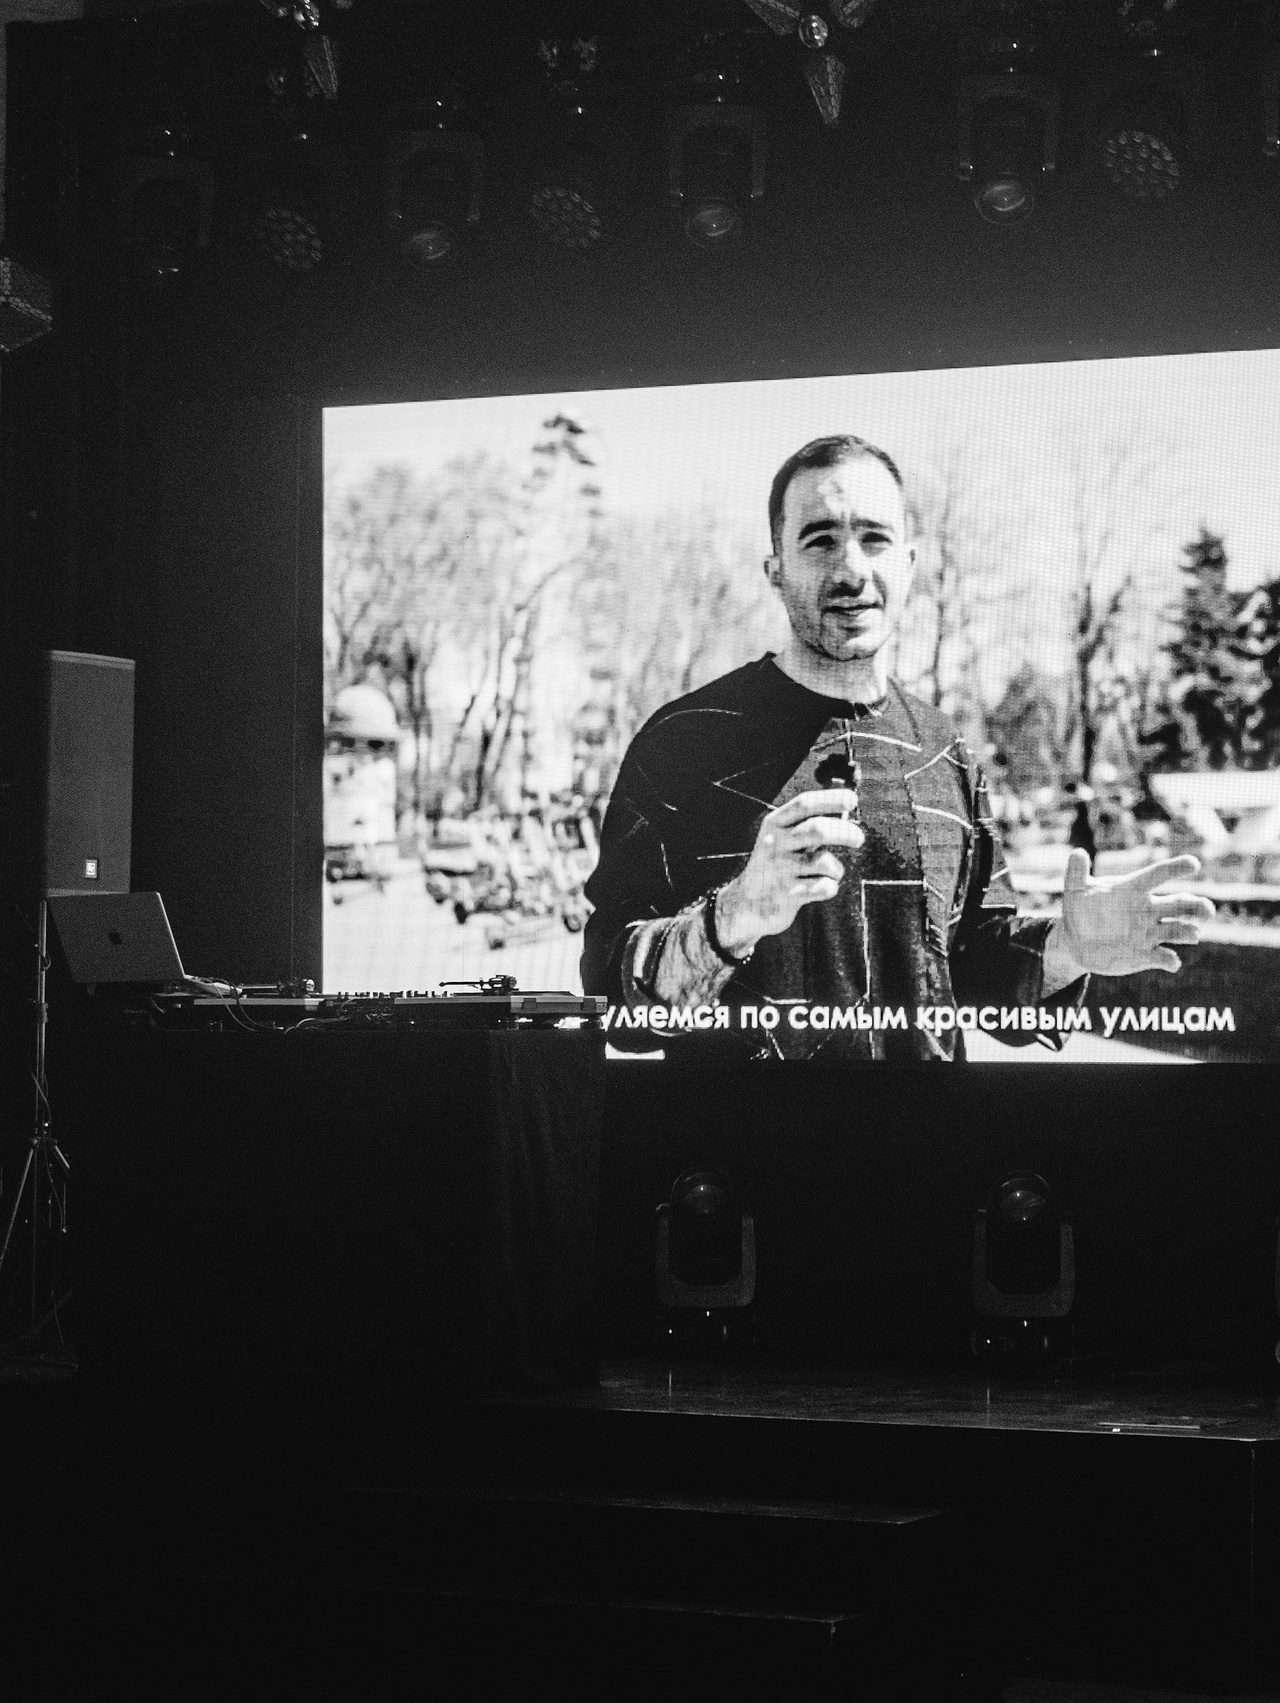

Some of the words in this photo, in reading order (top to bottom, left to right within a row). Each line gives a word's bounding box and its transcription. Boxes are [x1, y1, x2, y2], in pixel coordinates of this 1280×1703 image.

[740, 1005, 779, 1030] по
[787, 1005, 909, 1031] самым
[915, 1006, 1093, 1038] красивым
[1100, 1006, 1236, 1038] улицам
